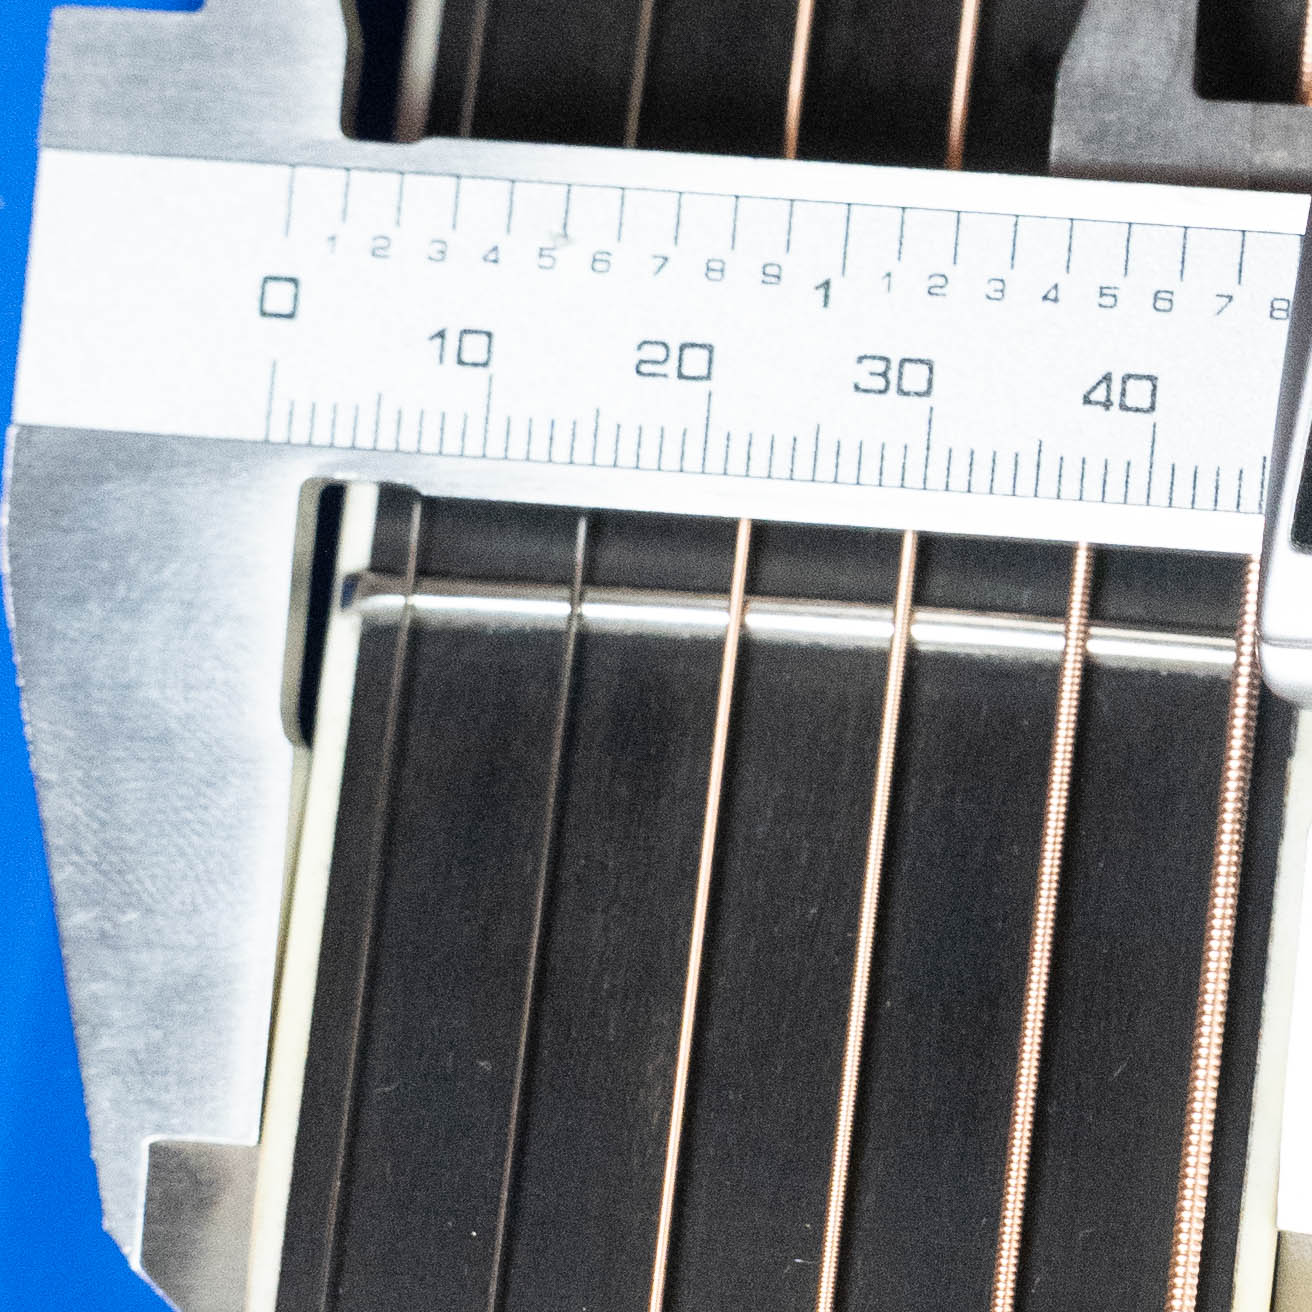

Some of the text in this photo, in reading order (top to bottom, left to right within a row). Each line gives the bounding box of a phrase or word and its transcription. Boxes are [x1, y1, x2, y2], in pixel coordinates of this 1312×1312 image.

[370, 234, 392, 260] 2
[427, 238, 449, 264] 3
[481, 244, 501, 266] 4
[536, 245, 557, 271] 5
[590, 249, 613, 275] 6
[650, 253, 671, 278] 7
[703, 257, 727, 283] 8
[760, 261, 784, 286] 9
[926, 272, 950, 298] 2
[985, 276, 1008, 303] 3
[1040, 281, 1062, 306] 4
[1096, 284, 1120, 310] 5
[1151, 288, 1176, 314] 6
[1214, 292, 1235, 317] 7
[1268, 296, 1291, 322] 8
[258, 274, 1159, 415] 0 10 20 30 40
